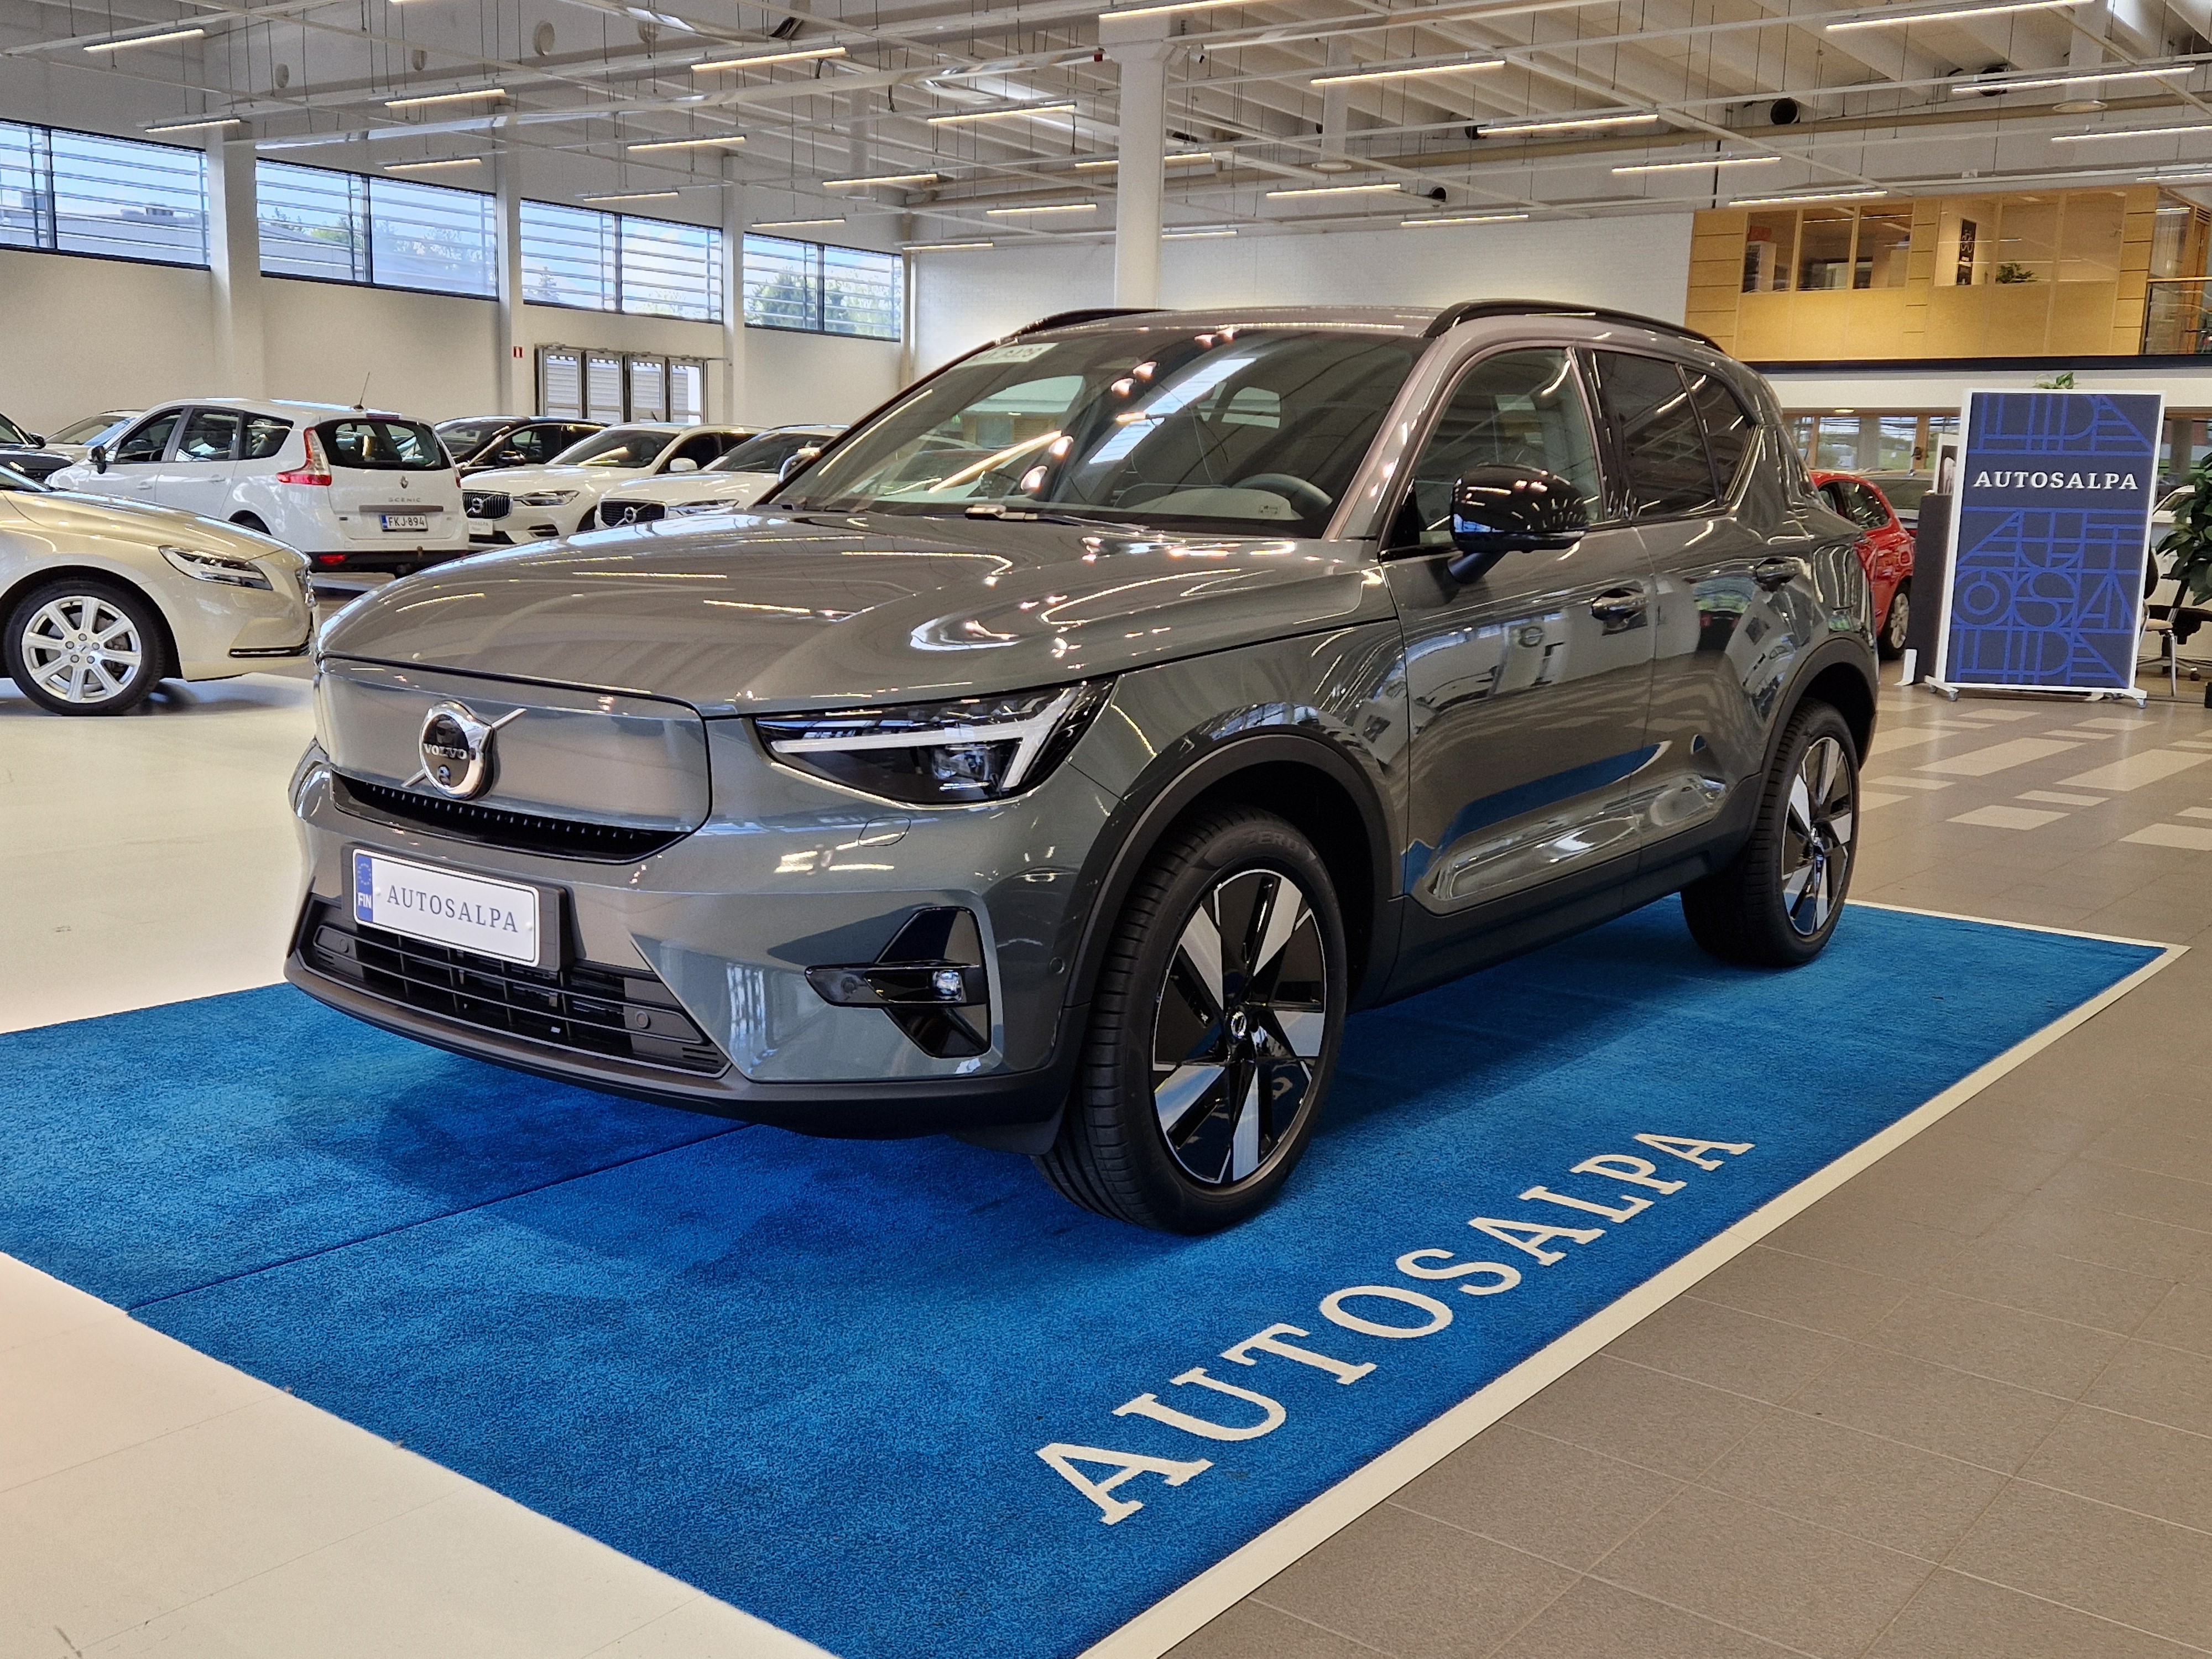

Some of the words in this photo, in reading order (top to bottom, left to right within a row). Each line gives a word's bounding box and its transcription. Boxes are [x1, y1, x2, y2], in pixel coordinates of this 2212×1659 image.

[1973, 471, 2138, 490] AUTOSALPA
[388, 517, 425, 526] FKJ-894
[423, 743, 467, 760] VOLVO
[358, 892, 372, 909] FIN
[387, 884, 519, 933] AUTOSALPA
[1035, 1133, 1756, 1526] AUTOSALPA
